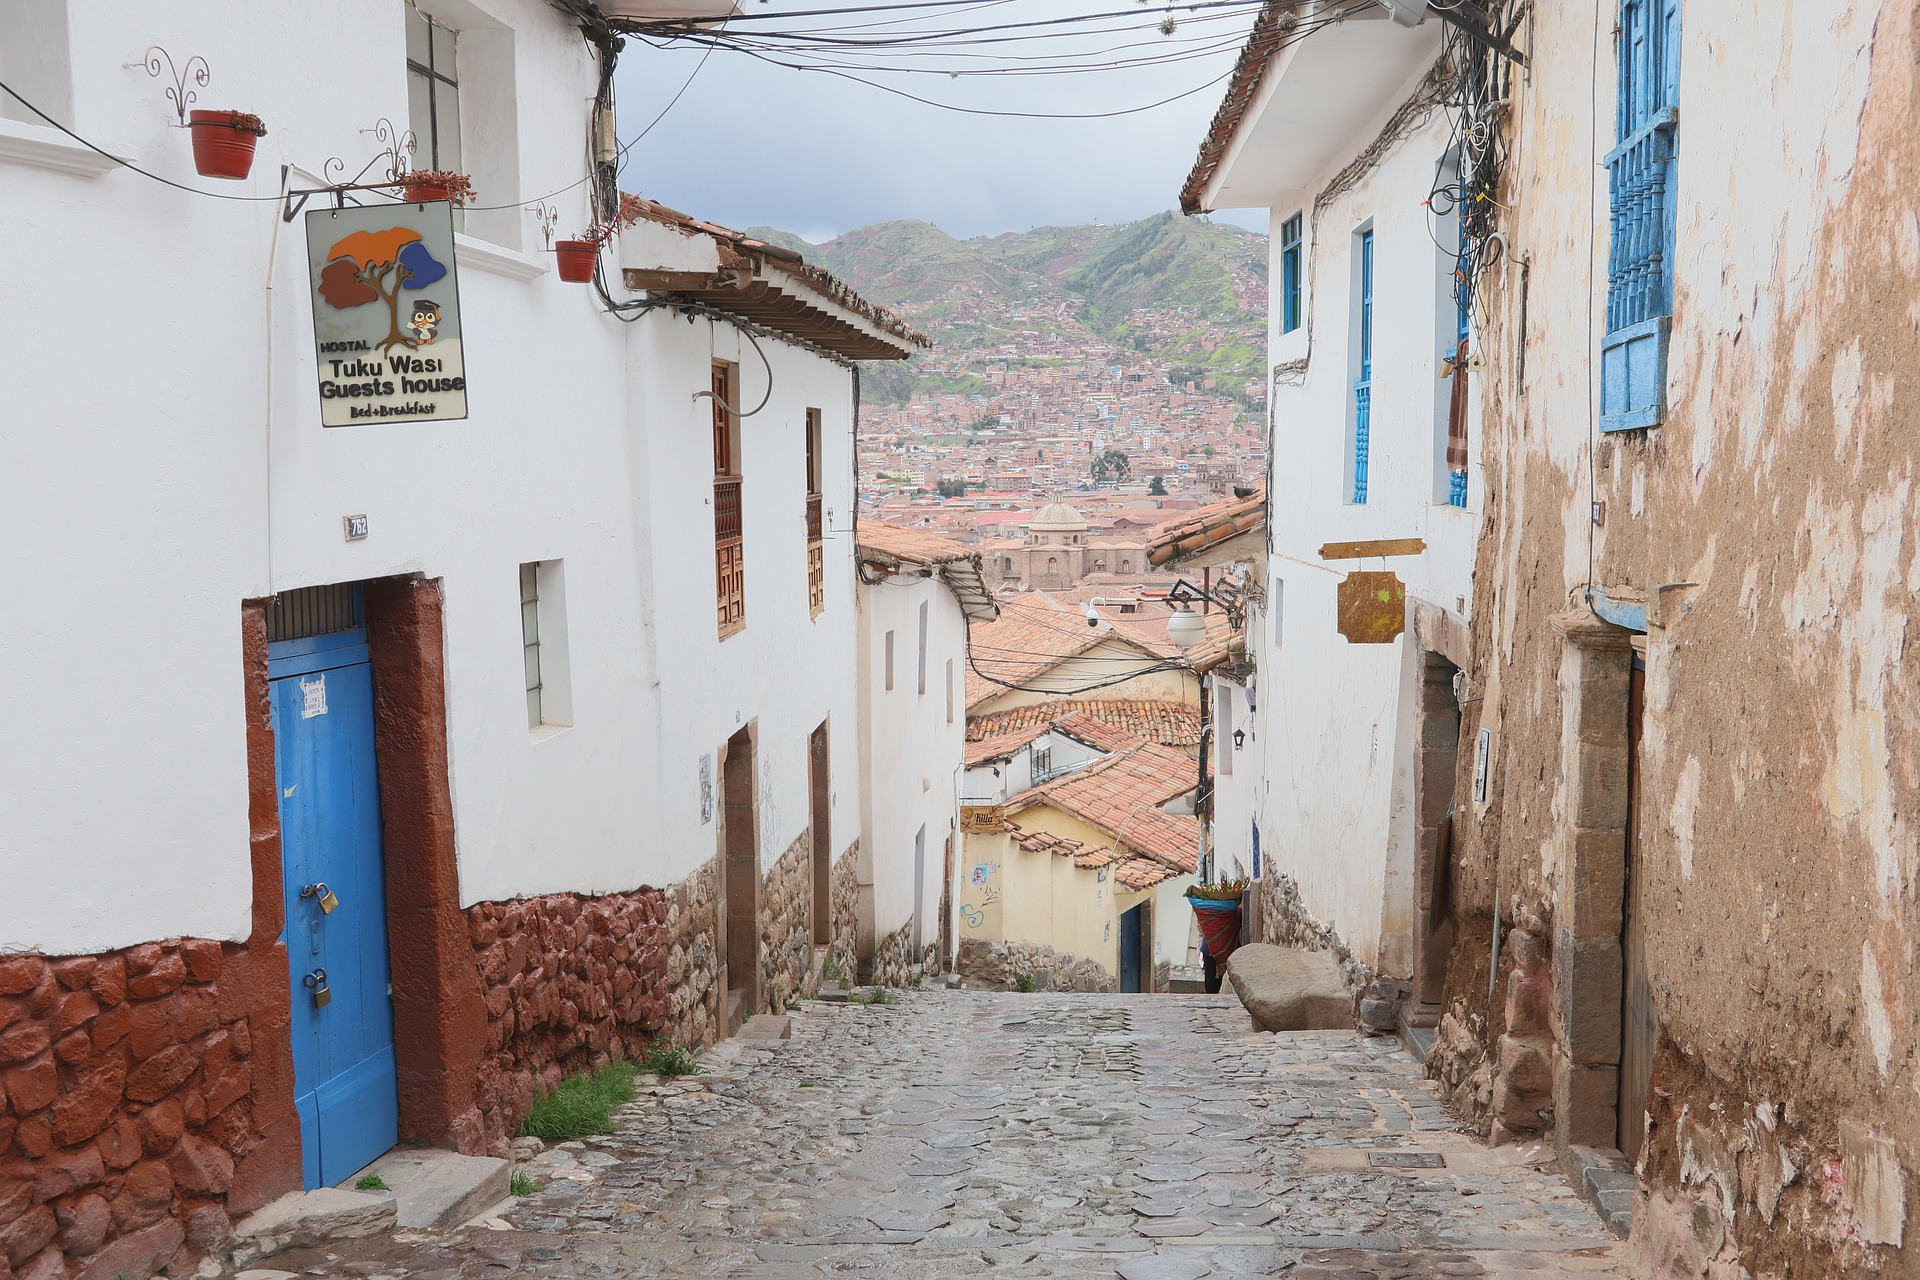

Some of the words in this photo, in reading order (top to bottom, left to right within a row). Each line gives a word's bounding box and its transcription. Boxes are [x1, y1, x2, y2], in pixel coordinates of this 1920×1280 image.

[320, 340, 371, 353] HOSTAL
[328, 359, 382, 378] Tuku
[389, 355, 442, 374] Wasi
[319, 379, 395, 399] Guests
[401, 376, 465, 394] house
[351, 517, 366, 535] 762
